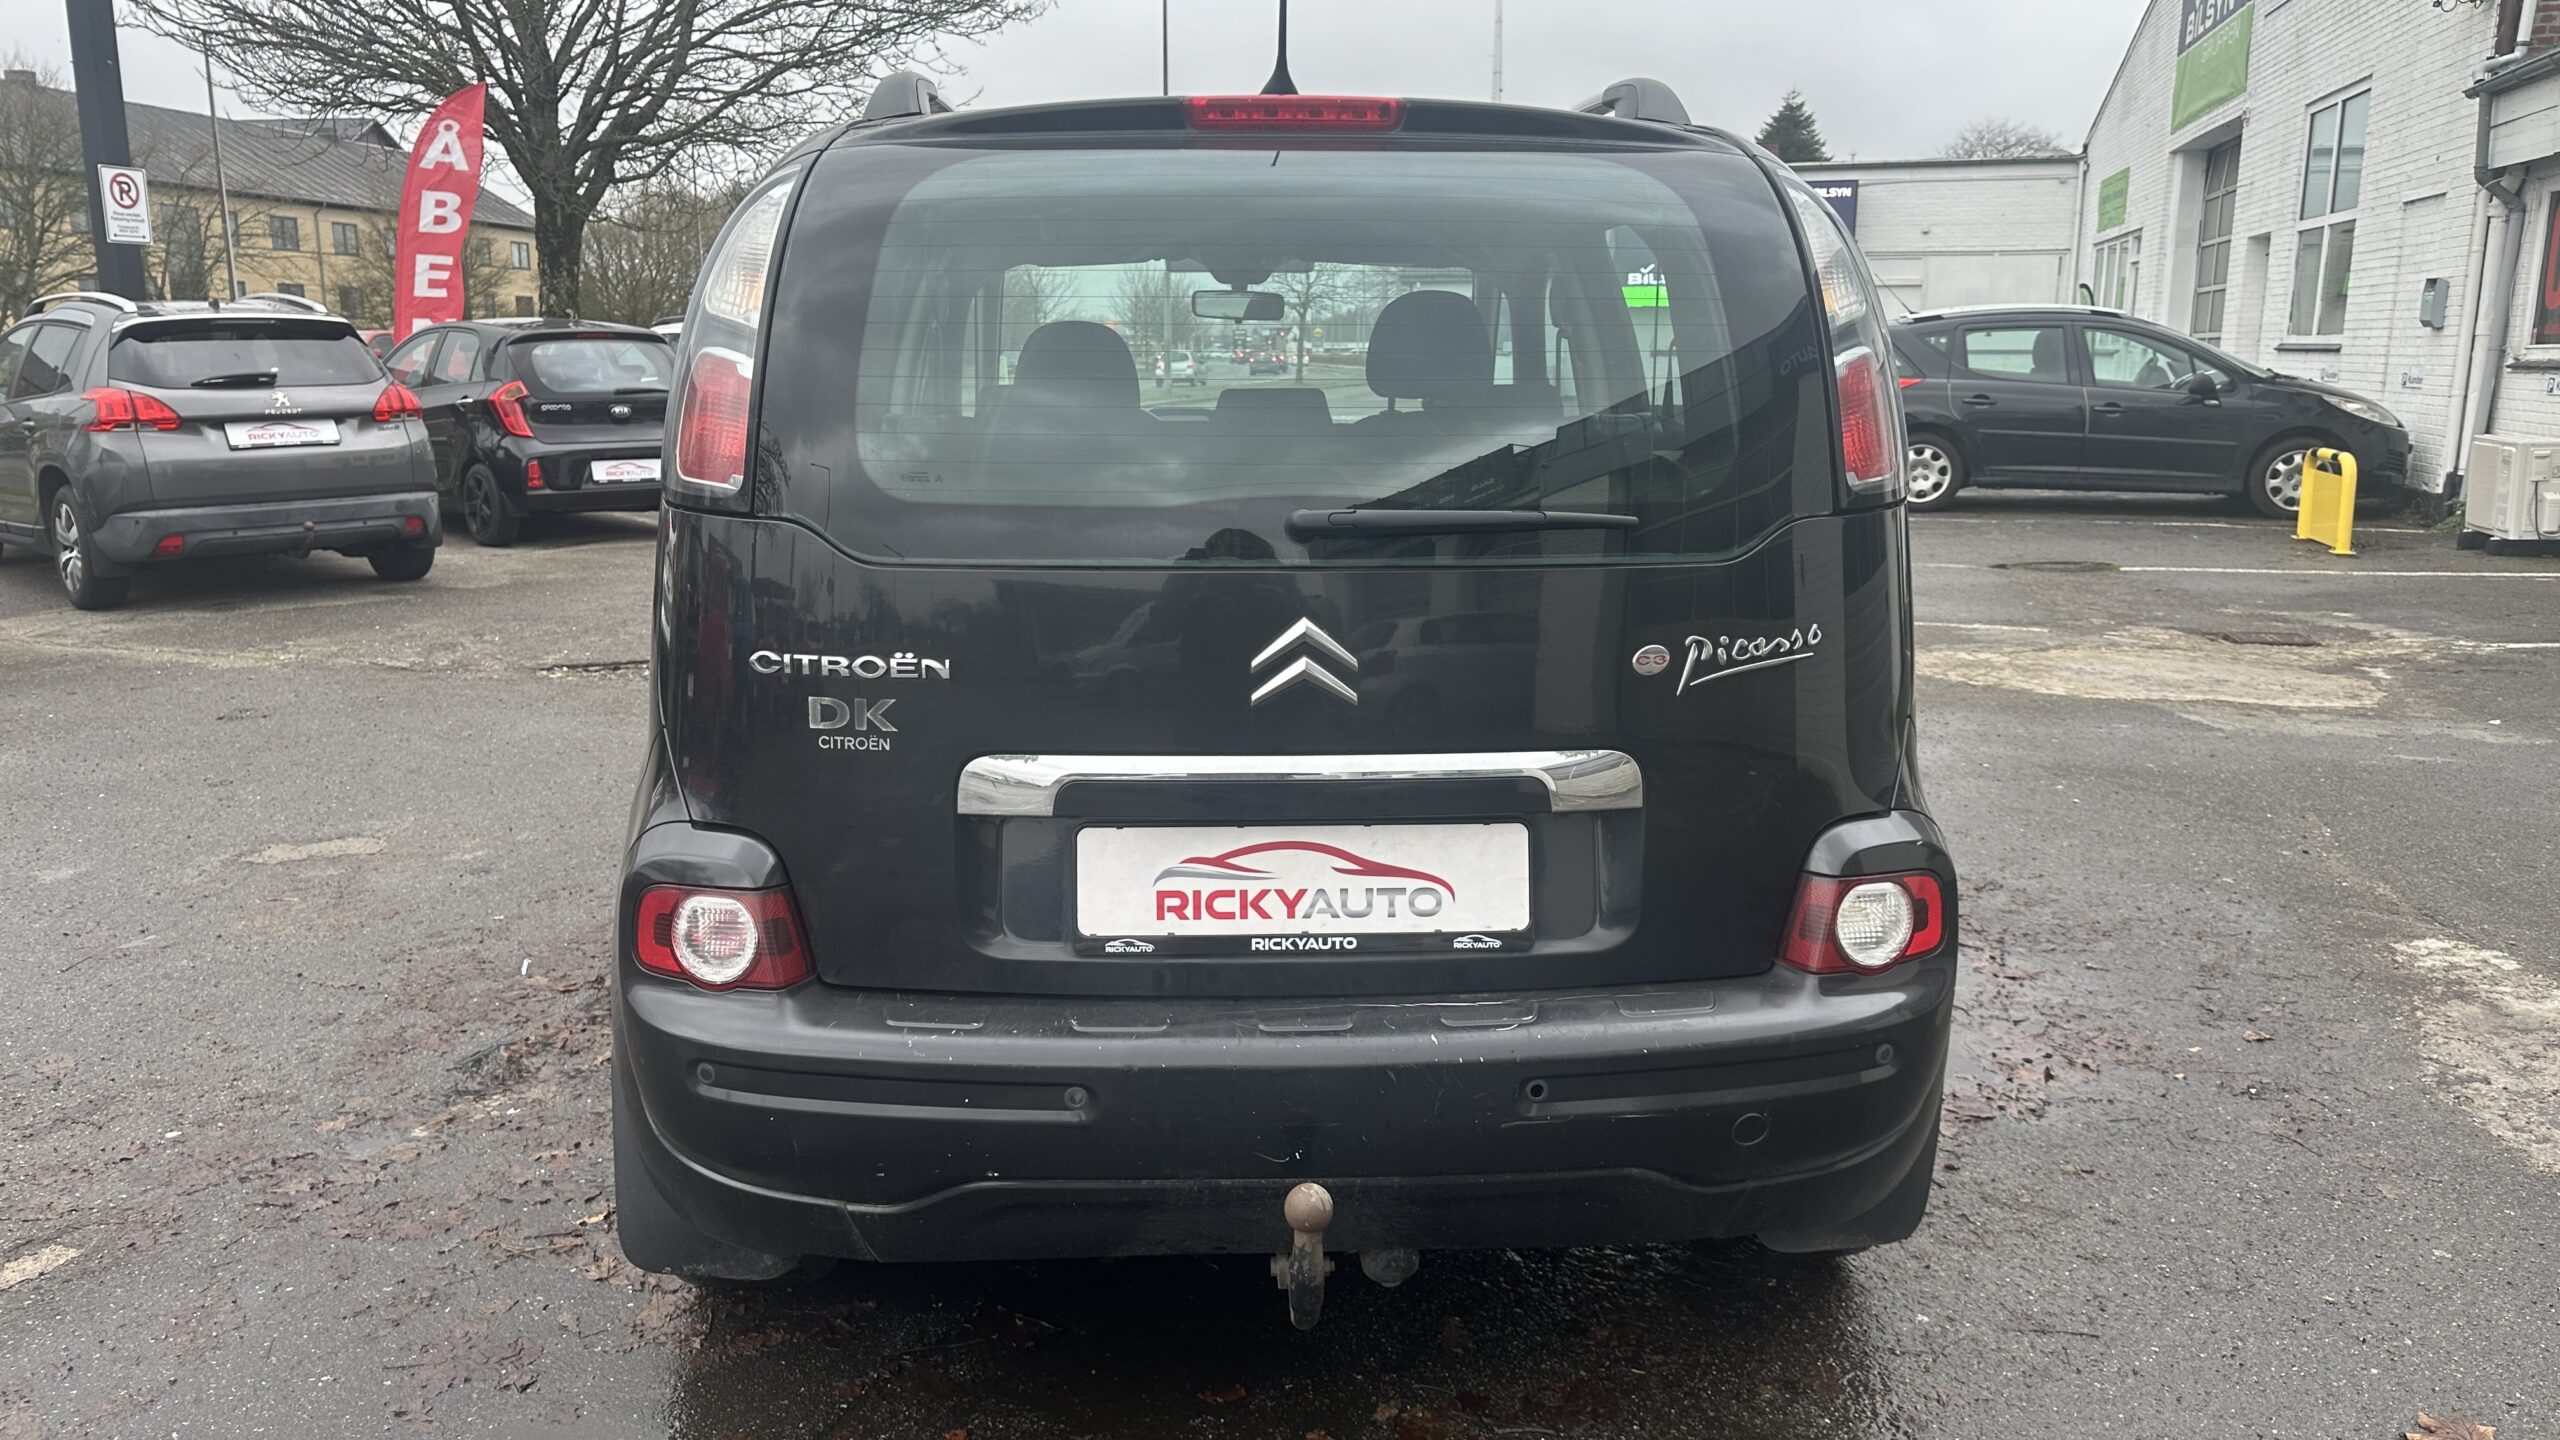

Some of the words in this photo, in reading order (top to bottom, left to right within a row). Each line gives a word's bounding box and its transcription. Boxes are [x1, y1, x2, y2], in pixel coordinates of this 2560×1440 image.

[1814, 187, 1852, 198] ILSYN
[749, 650, 951, 681] CITROËN
[1676, 623, 1822, 696] Picasso
[807, 696, 899, 734] DK
[818, 735, 891, 751] CITROËN
[1155, 886, 1443, 921] RICKYAUTO
[1104, 943, 1154, 953] RICKYAUTO
[1250, 936, 1358, 951] RICKYAUTO
[1453, 938, 1502, 949] RICKYAUTO
